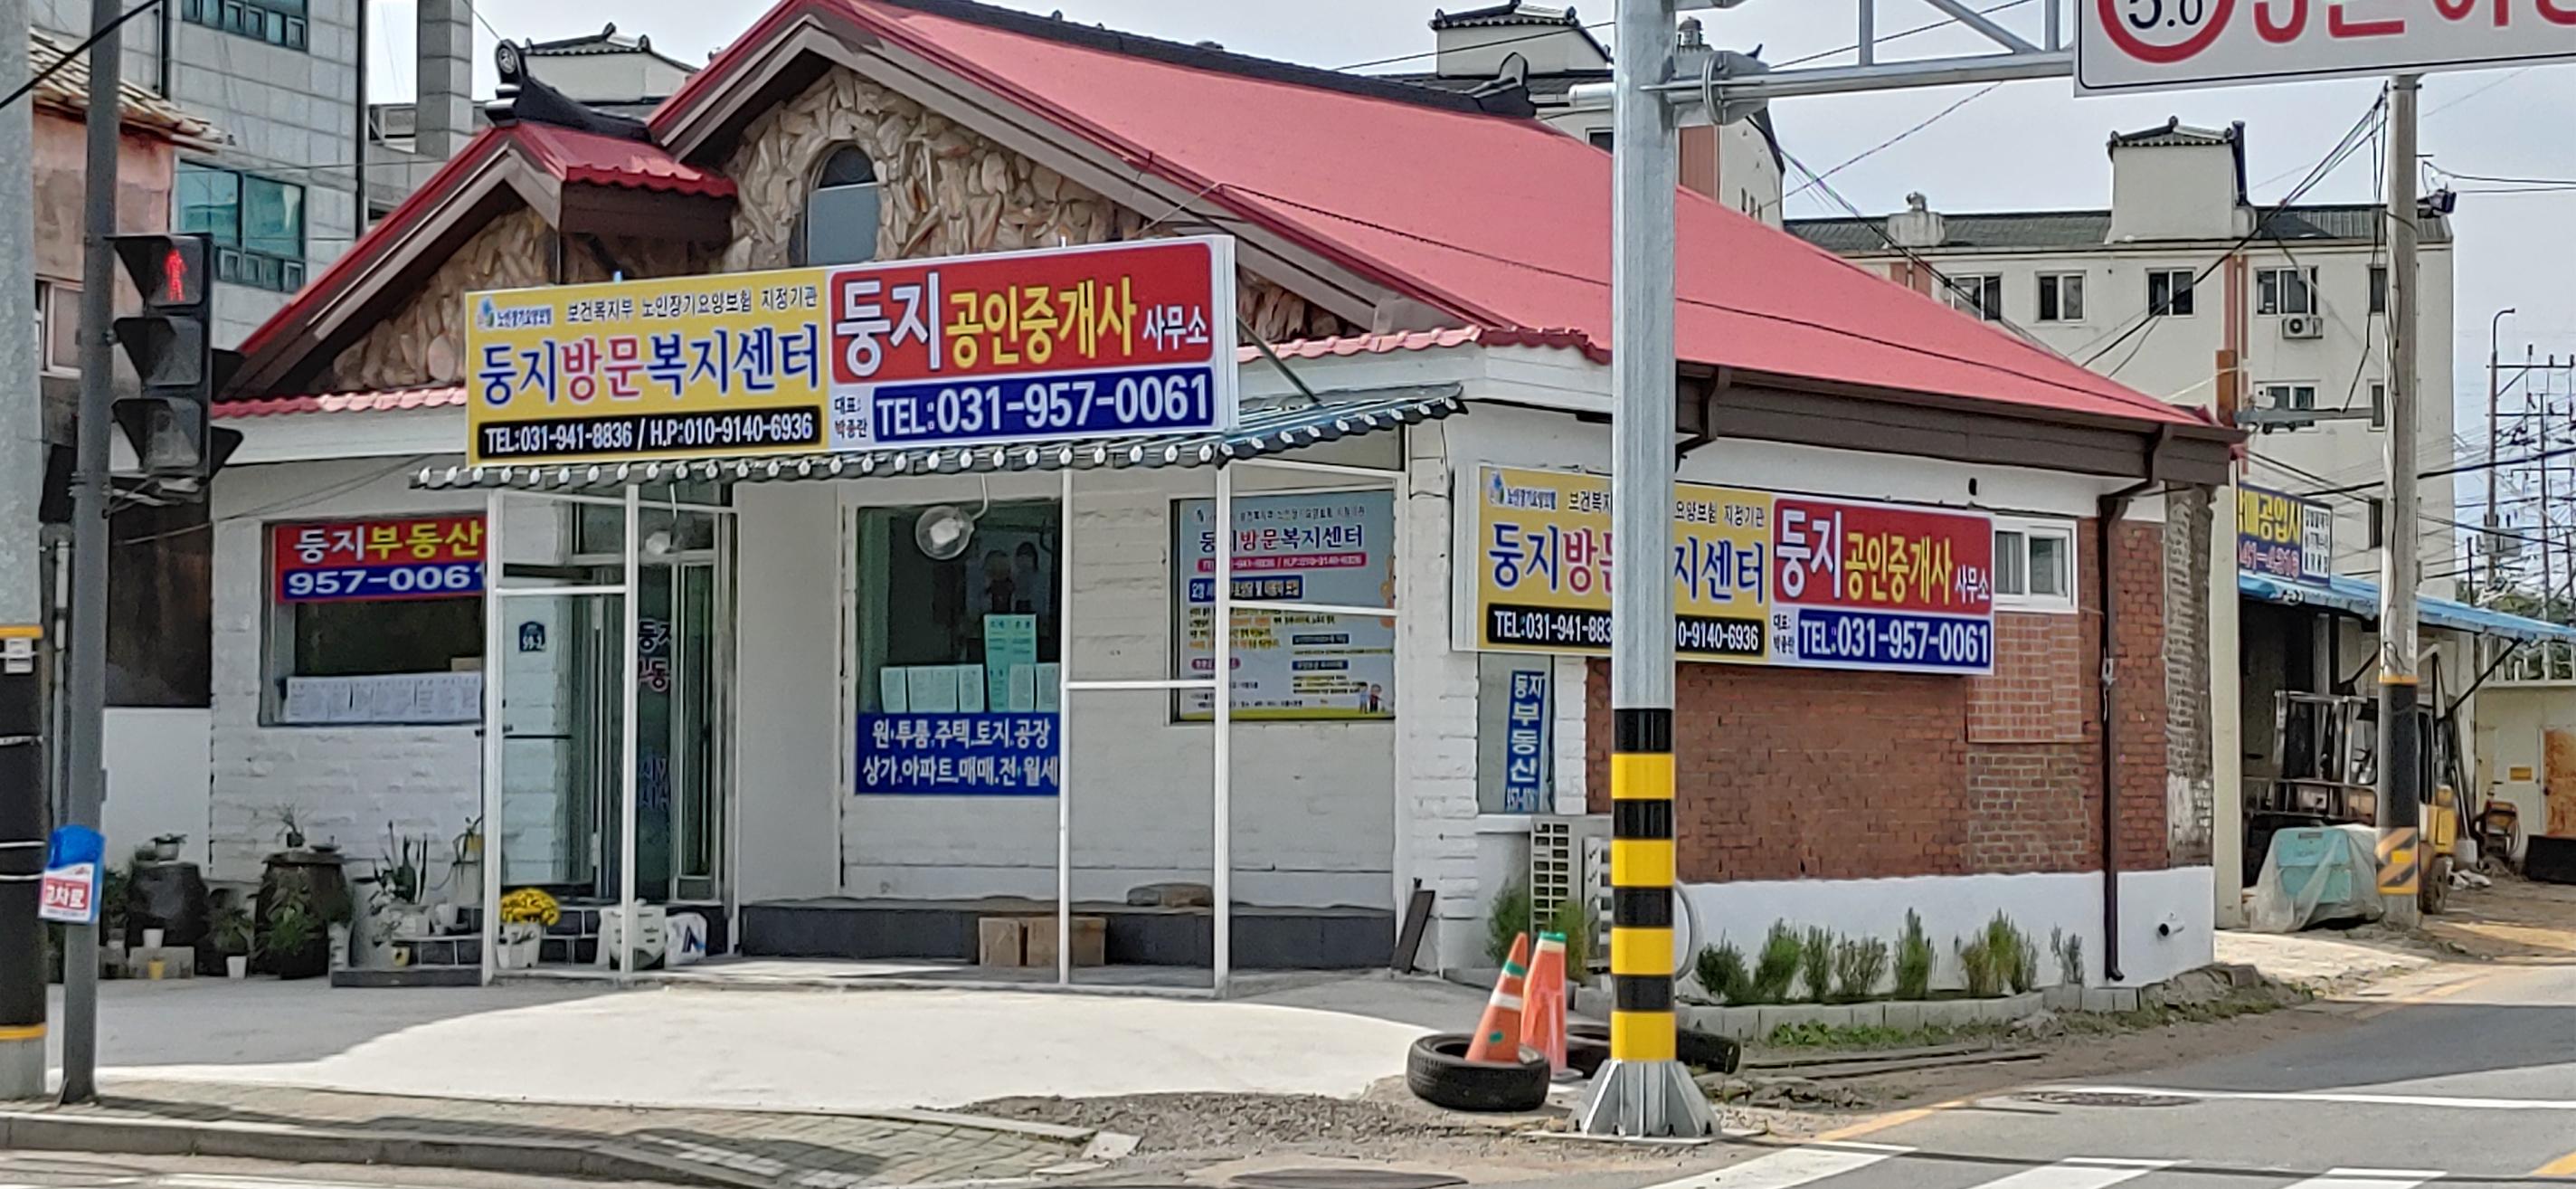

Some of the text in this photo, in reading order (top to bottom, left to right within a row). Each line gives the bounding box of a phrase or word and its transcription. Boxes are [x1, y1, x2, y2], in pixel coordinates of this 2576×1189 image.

[567, 287, 818, 322] 보건복지부 노인장기요양보험 지정기관
[835, 271, 1209, 376] 둥지 공인중개사 사무소
[478, 323, 818, 406] 둥지방문복지센터
[876, 373, 1208, 436] TEL:031-957-0061
[484, 421, 632, 453] TEL:031-941-8836
[649, 412, 813, 447] H.P:010-9140-6936
[1568, 490, 1612, 514] 보건복지
[1724, 503, 1765, 528] 지정기관
[1776, 509, 1990, 605] 둥지 공인중개사 사무소
[1493, 610, 1612, 642] TEL:031-941-883
[1800, 615, 1988, 663] TEL:031-957-0061
[1514, 674, 1542, 699] 둥지
